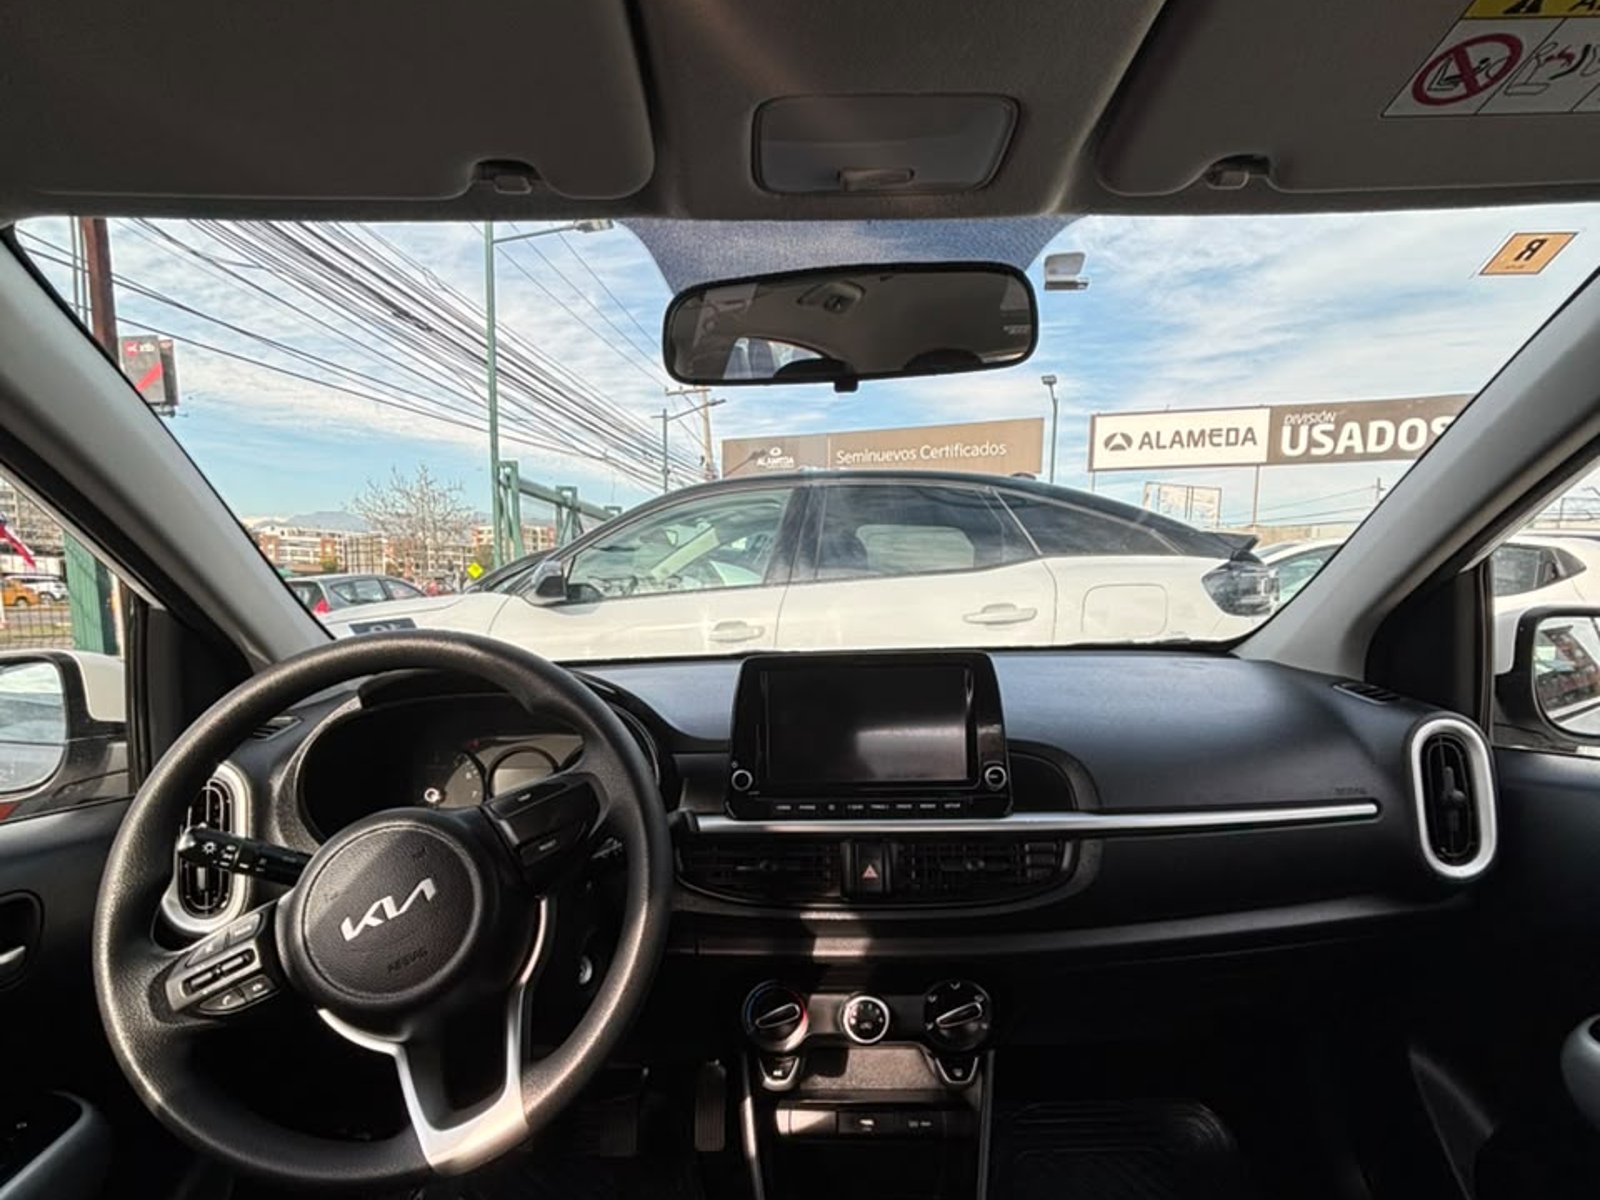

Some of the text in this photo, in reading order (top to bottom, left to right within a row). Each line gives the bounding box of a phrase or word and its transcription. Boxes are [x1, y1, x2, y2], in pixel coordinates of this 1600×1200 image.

[1138, 427, 1258, 451] ALAMEDA
[836, 441, 1007, 464] Seminuevos Certificados
